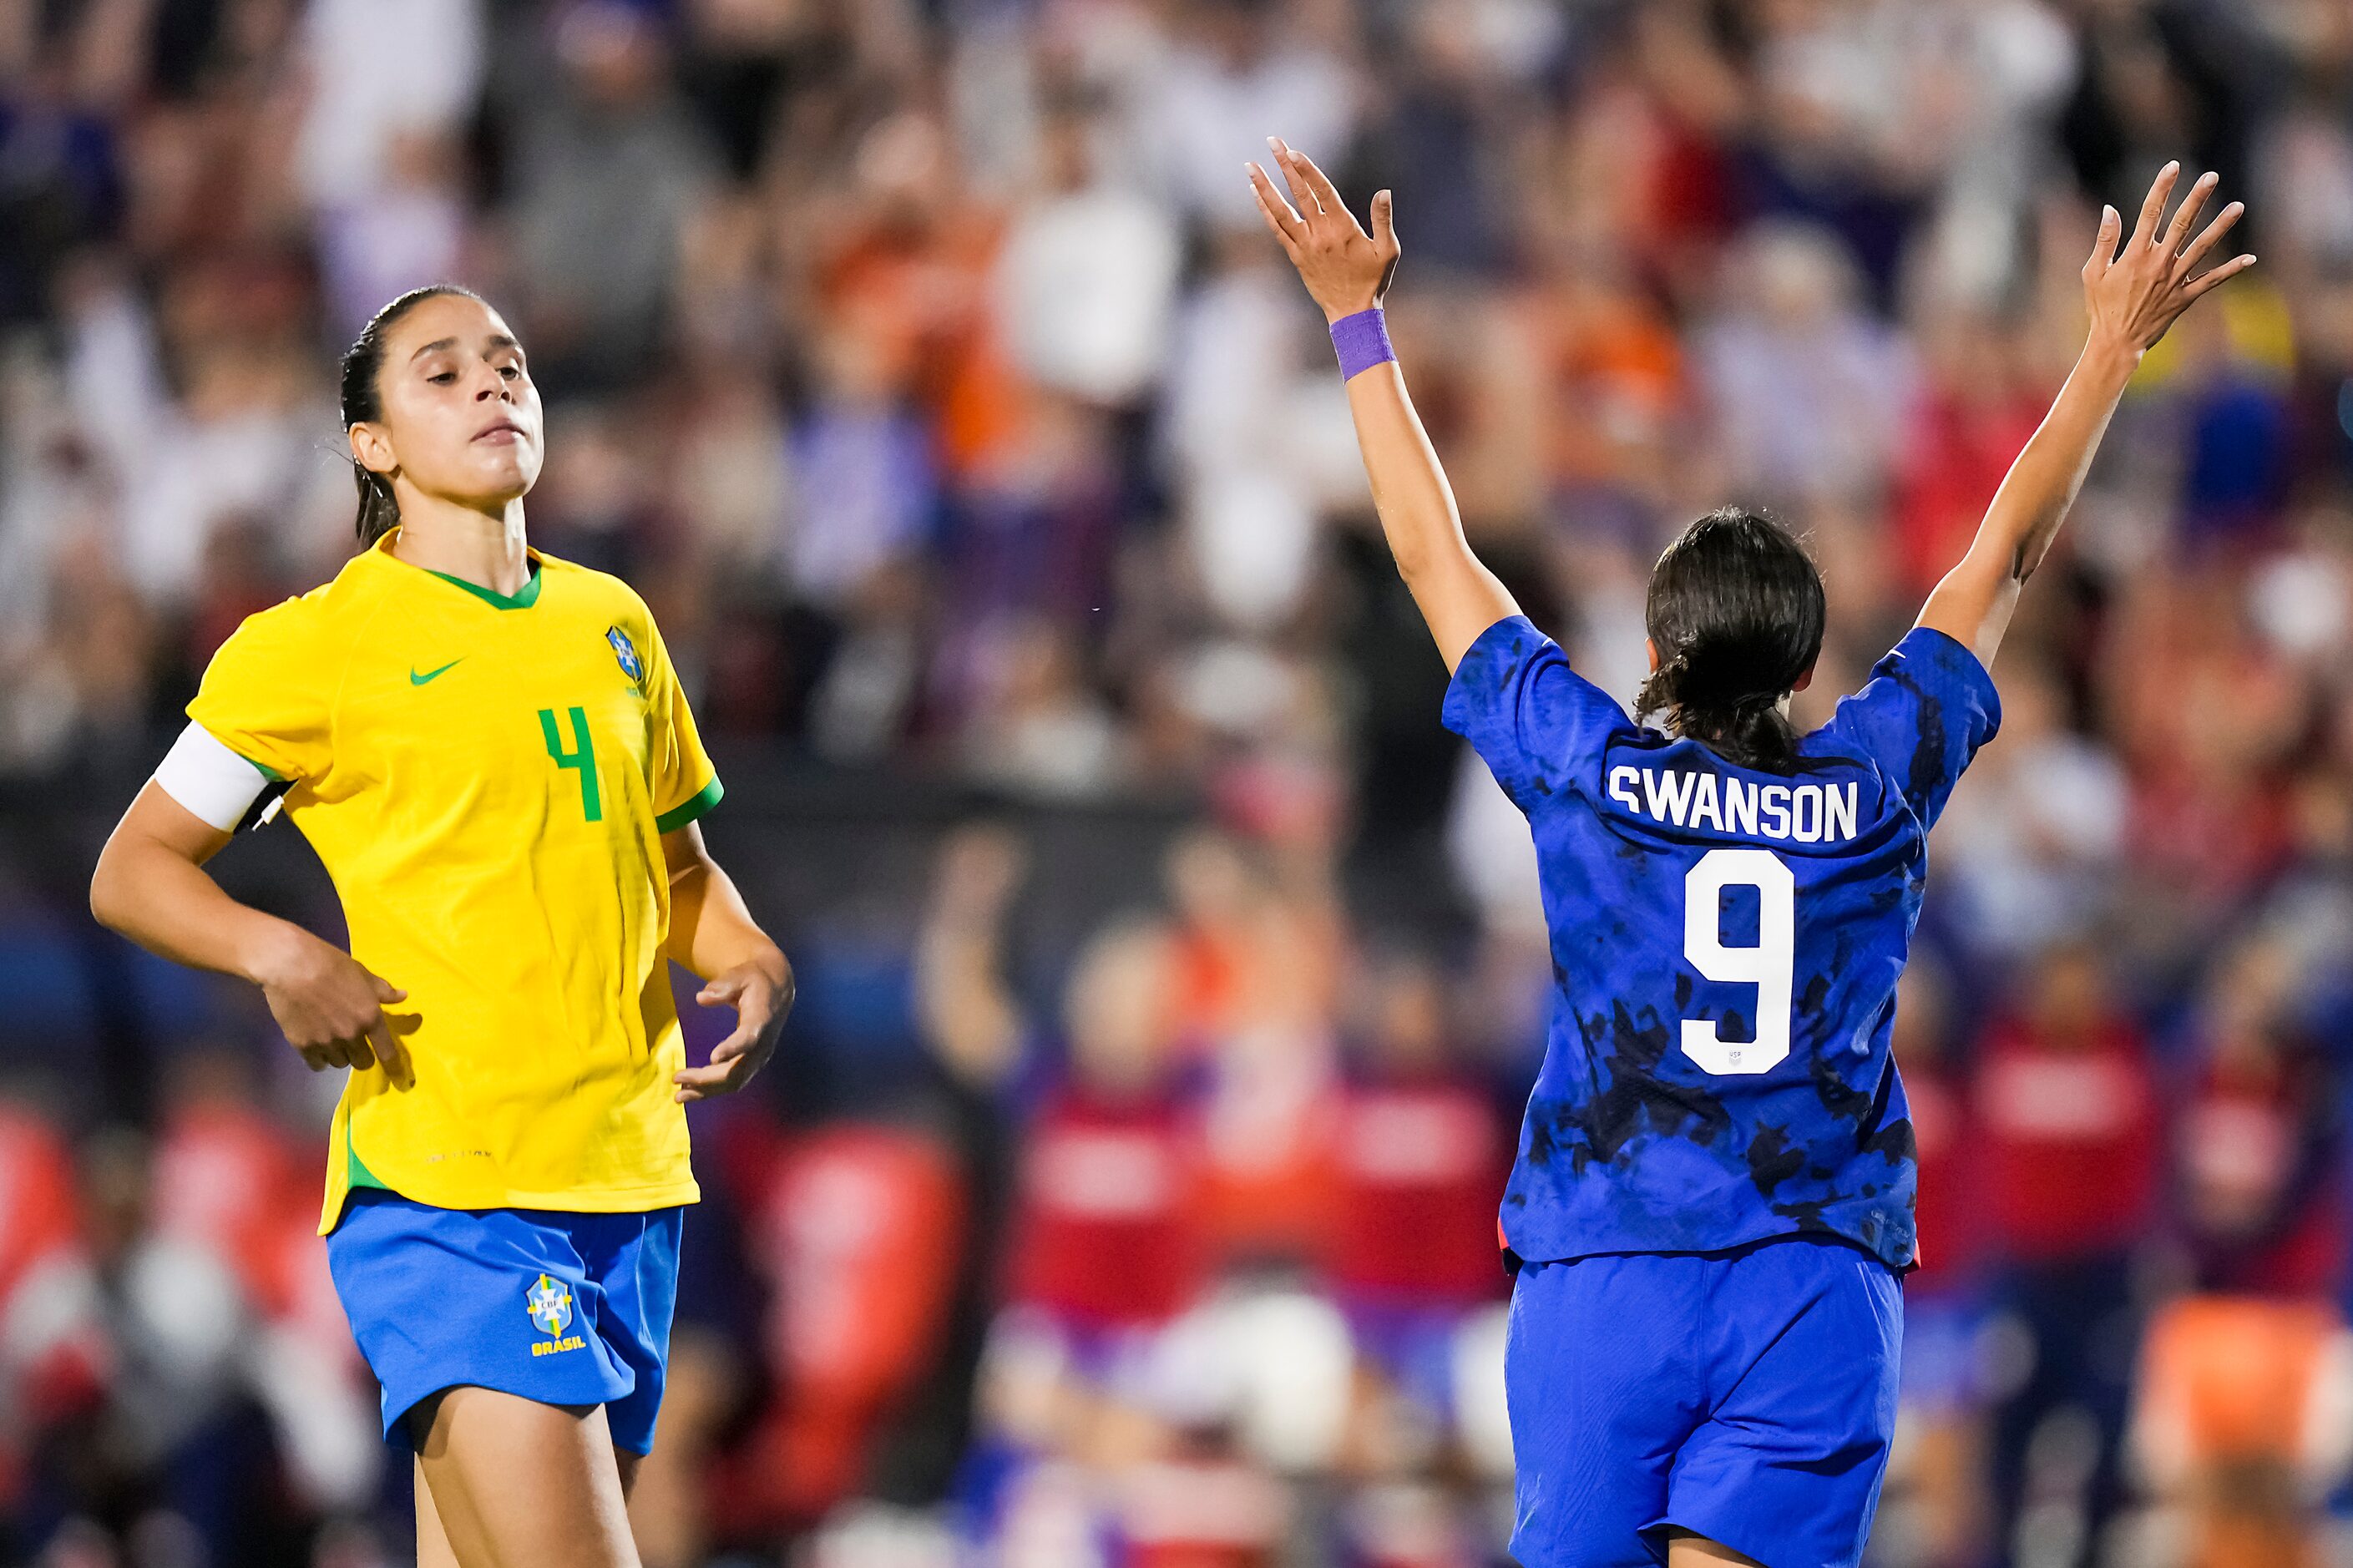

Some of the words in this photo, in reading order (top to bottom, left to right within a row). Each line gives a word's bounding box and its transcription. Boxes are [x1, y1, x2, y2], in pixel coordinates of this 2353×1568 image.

[538, 706, 602, 822] 4
[1608, 765, 1858, 843] SWANSON
[1680, 849, 1794, 1075] 9
[531, 1335, 587, 1357] BRASIL
